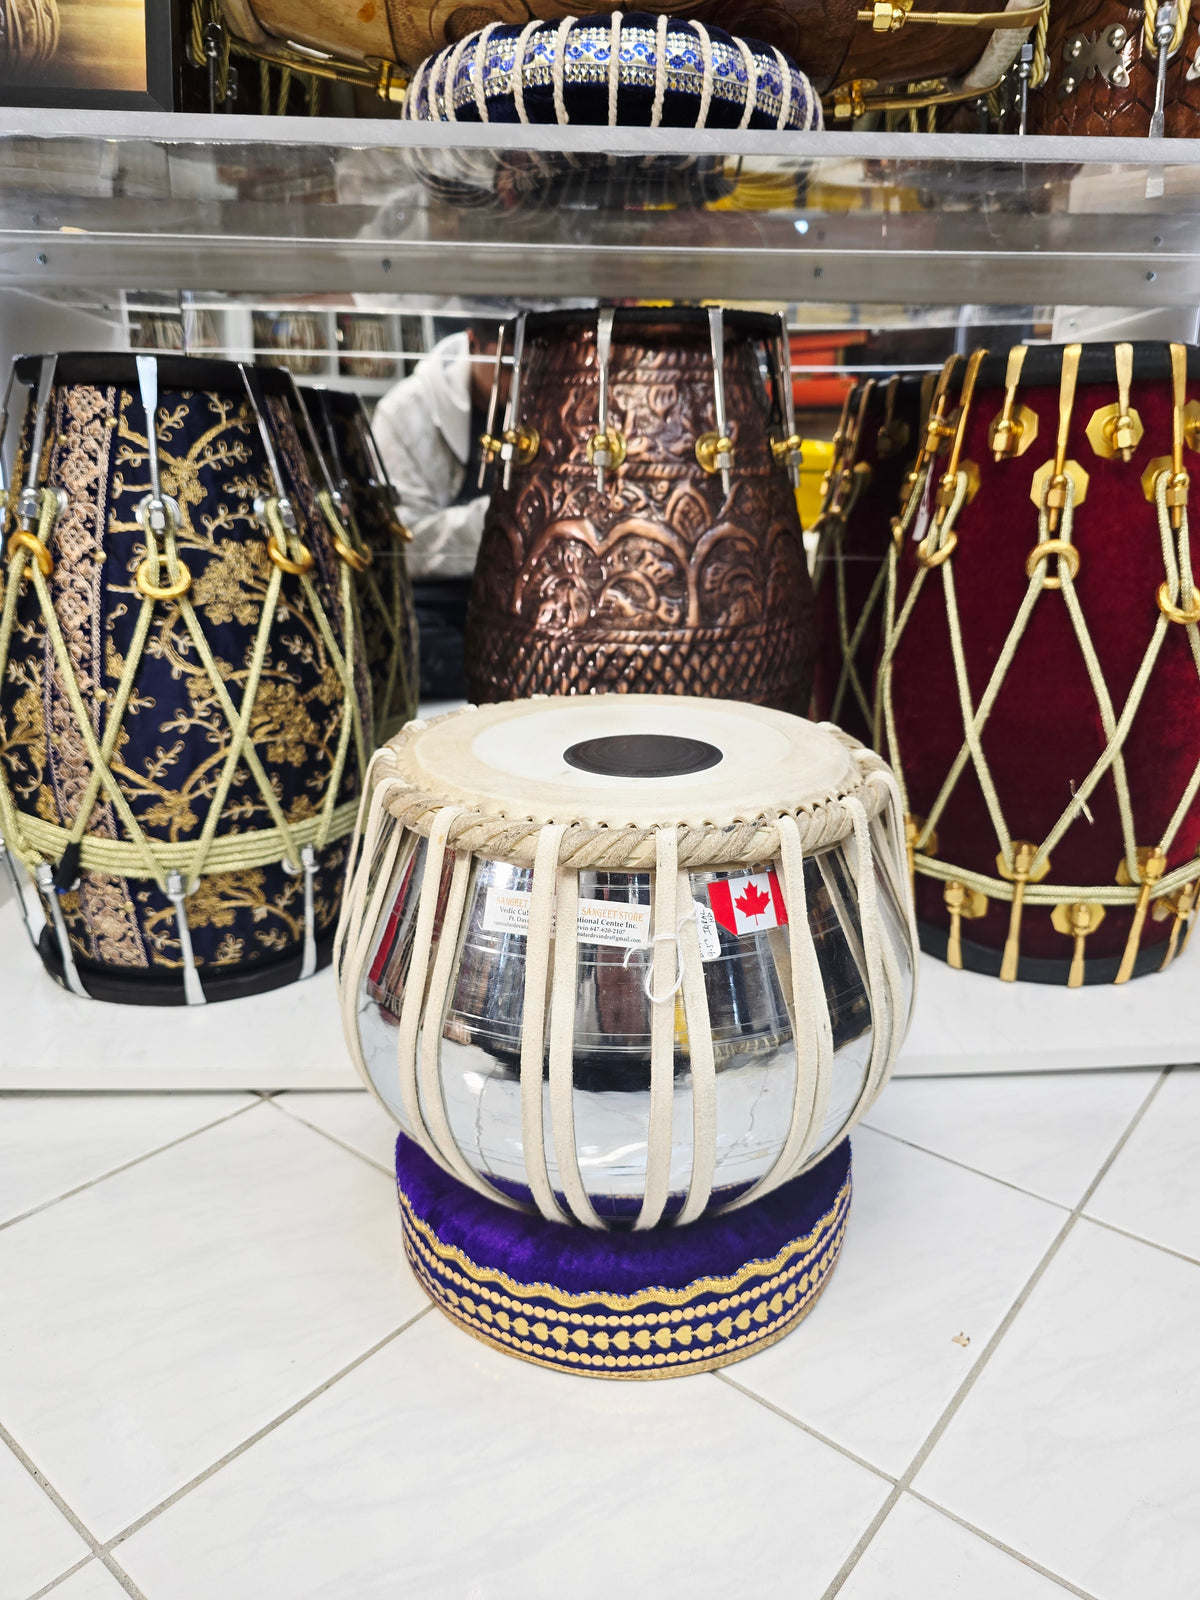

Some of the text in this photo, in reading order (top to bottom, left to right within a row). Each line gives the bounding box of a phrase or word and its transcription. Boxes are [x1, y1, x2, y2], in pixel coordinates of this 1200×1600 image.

[496, 896, 529, 908] SANGEET
[499, 906, 517, 914] Vedic
[580, 907, 643, 922] SANGEET STORE
[600, 919, 624, 927] Centre
[590, 927, 626, 935] 647-620-2107
